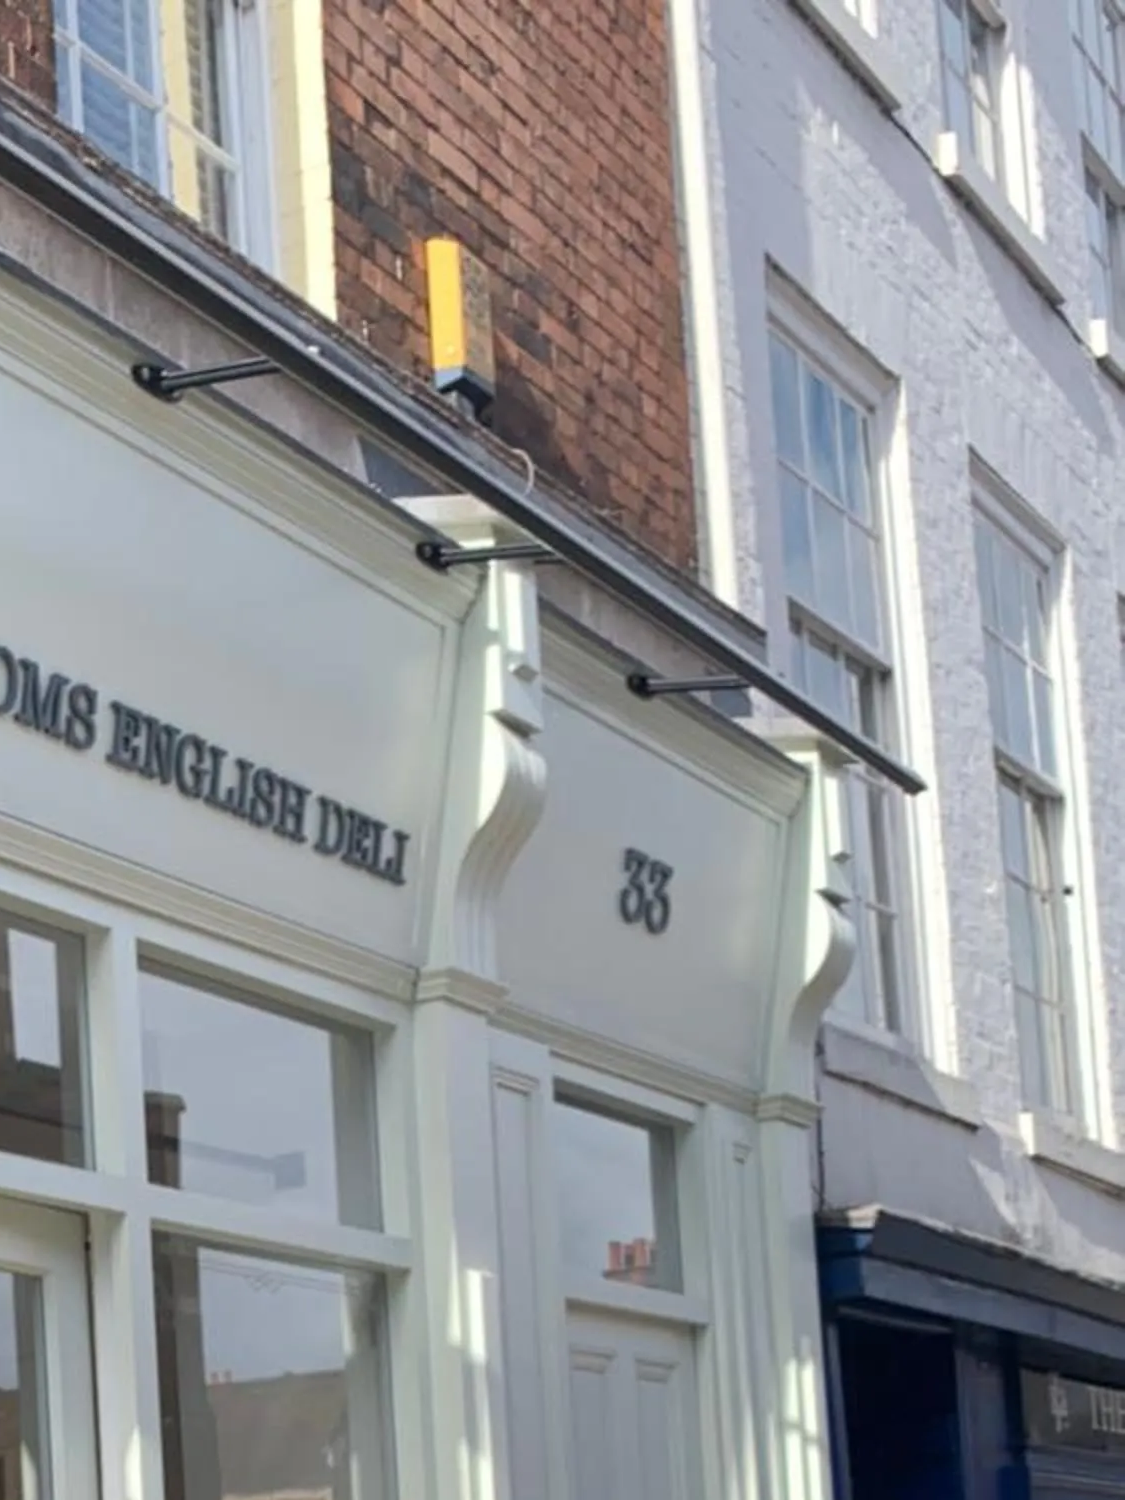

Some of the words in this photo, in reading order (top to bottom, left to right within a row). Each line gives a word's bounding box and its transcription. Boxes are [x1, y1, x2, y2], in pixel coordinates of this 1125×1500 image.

[106, 701, 311, 846] ENGLISH
[313, 794, 410, 886] DELI
[619, 847, 674, 936] 33
